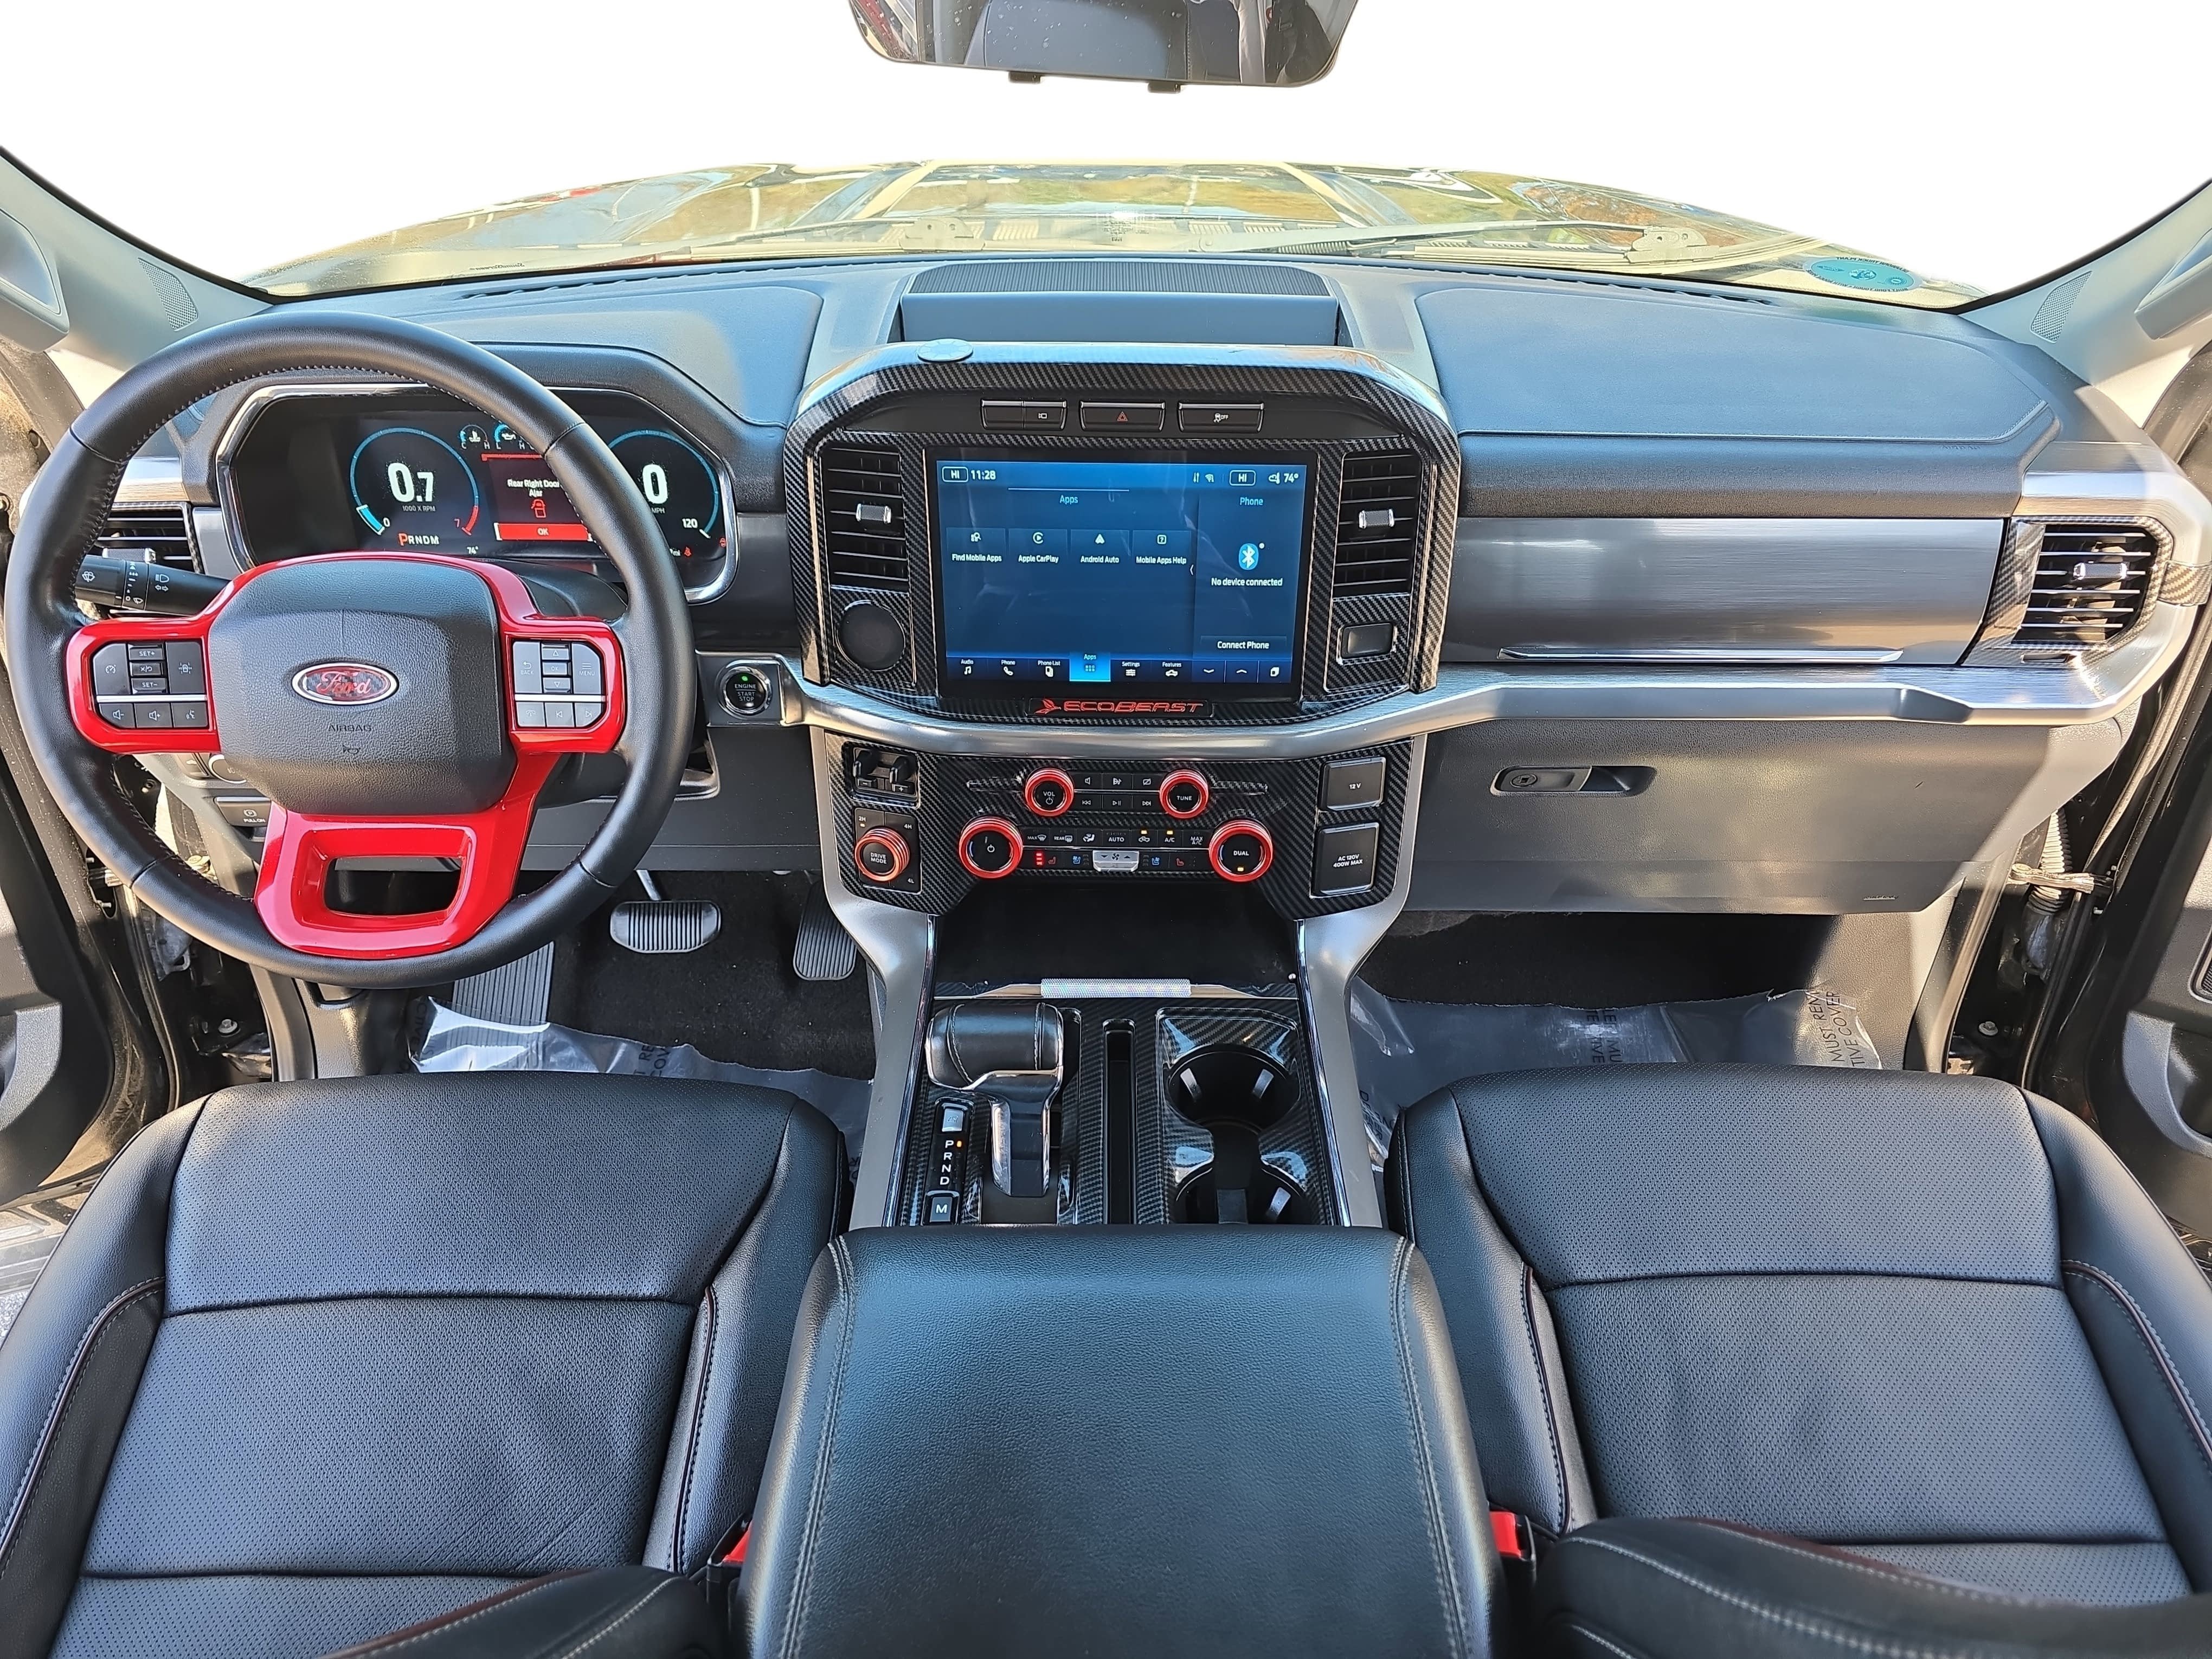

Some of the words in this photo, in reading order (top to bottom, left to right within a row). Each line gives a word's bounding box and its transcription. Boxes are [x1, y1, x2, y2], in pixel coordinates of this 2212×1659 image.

[950, 470, 960, 479] HI
[970, 470, 996, 480] 11:28
[1238, 473, 1248, 483] HI
[388, 462, 434, 503] 0.7
[507, 479, 524, 487] Rear
[524, 479, 543, 488] Right
[642, 464, 668, 504] 0
[529, 489, 543, 498] Ajar
[1059, 494, 1078, 505] Apps
[1239, 497, 1264, 506] Phone
[383, 517, 390, 527] 0
[454, 518, 460, 528] 7
[682, 518, 698, 528] 120
[537, 528, 549, 536] OK
[951, 554, 966, 562] Find
[966, 554, 986, 562] Mobile
[986, 555, 1002, 563] Apps
[1018, 555, 1036, 563] Apple
[1036, 555, 1059, 563] CarPlay
[1081, 555, 1104, 563] Android
[1136, 556, 1156, 564] Mobile
[1173, 557, 1187, 565] Help
[1211, 578, 1221, 586] No
[1222, 578, 1245, 586] device
[1246, 578, 1283, 587] connected
[1217, 641, 1246, 650] Connect
[1246, 641, 1270, 650] Phone
[317, 671, 371, 695] Ford
[328, 724, 372, 732] AIRBAG
[1826, 991, 1852, 1037] COVER
[1819, 1026, 1846, 1062] MUST
[1843, 1039, 1866, 1067] TIVE
[945, 1140, 954, 1149] P
[943, 1152, 953, 1161] R
[941, 1164, 951, 1173] N
[940, 1176, 950, 1185] D
[936, 1204, 948, 1214] M
